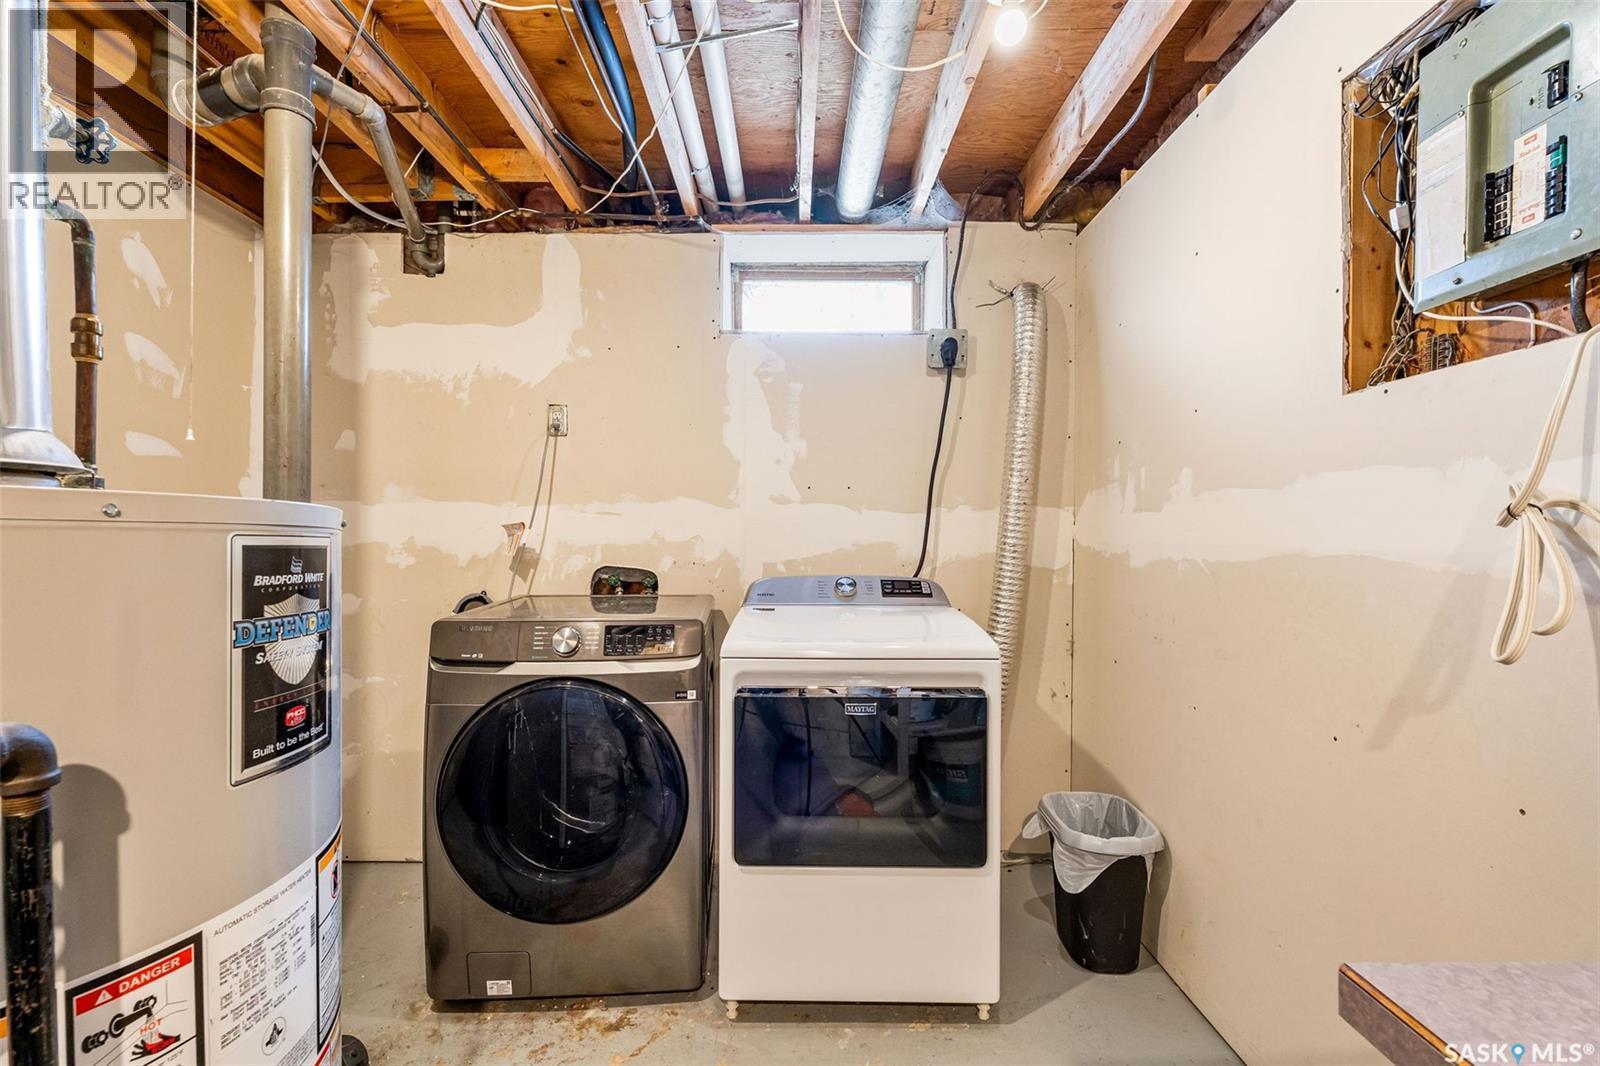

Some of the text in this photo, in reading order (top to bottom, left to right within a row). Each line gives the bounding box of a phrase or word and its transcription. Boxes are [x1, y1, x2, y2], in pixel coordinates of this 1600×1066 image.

[253, 572, 325, 586] BRADFORD WHITE
[233, 609, 331, 648] DEFENDER
[253, 744, 275, 760] Built
[276, 741, 285, 750] to
[287, 736, 298, 747] be
[299, 731, 310, 740] the
[310, 723, 324, 735] Best
[213, 910, 253, 936] AUTOMATIC
[253, 893, 279, 915] STORAGE
[118, 957, 181, 994] DANGER
[140, 1018, 162, 1036] HOT
